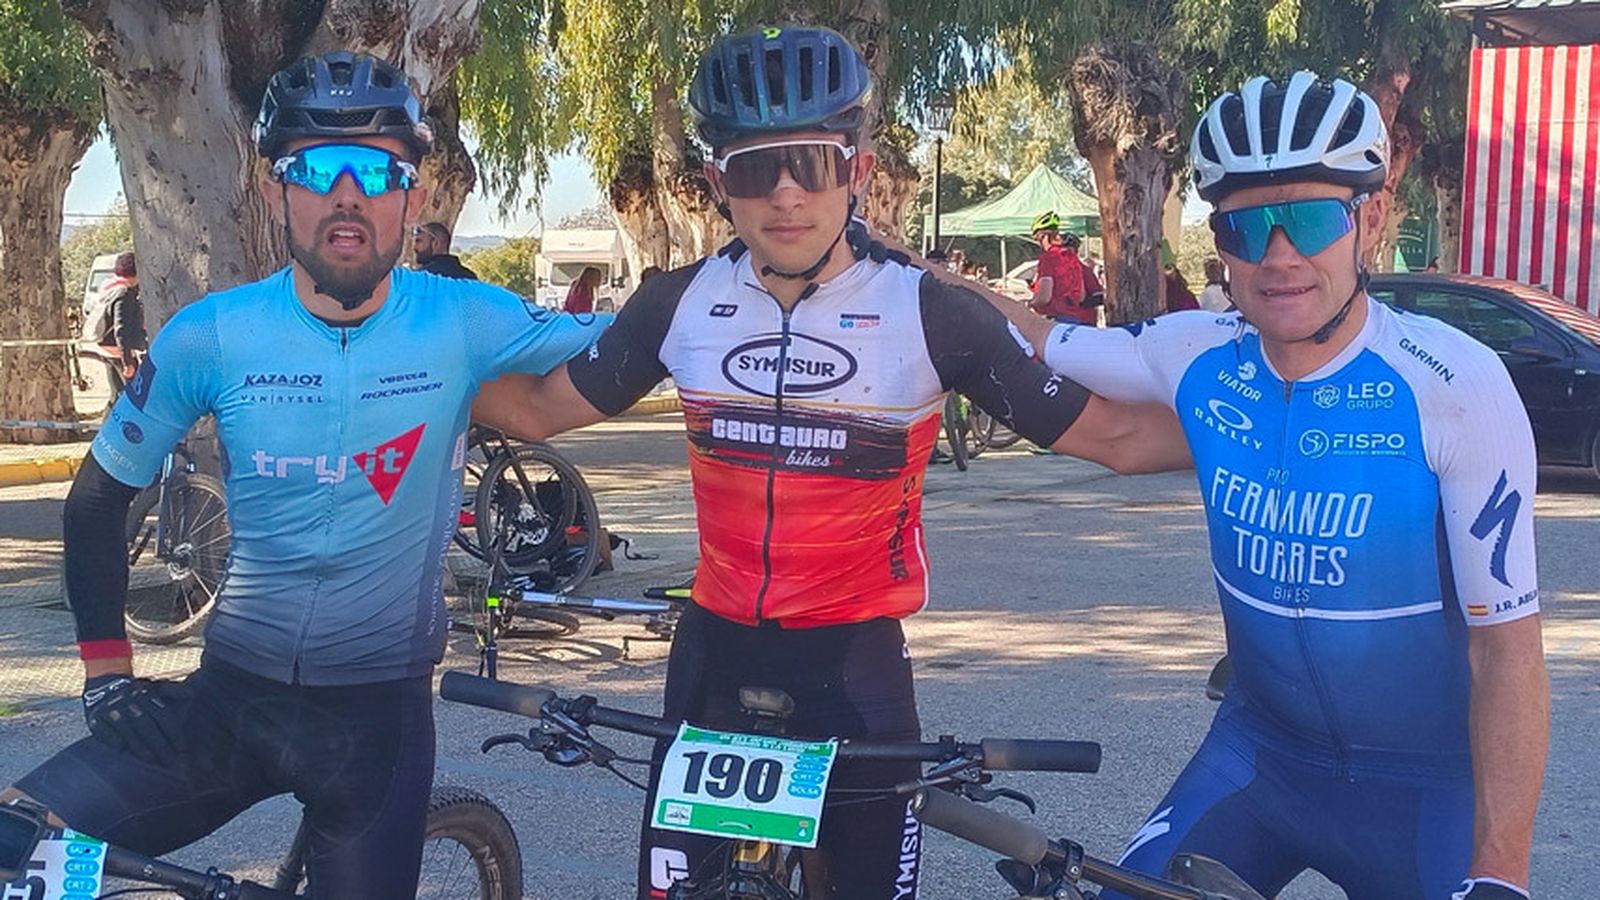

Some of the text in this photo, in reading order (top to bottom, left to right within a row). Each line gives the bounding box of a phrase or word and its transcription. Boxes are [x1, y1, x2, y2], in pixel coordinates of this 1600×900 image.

[738, 355, 836, 378] SYMISUR
[1398, 338, 1455, 385] GARMIN
[244, 374, 323, 388] KAZAJOZ
[360, 382, 444, 400] ROCKRIDER
[1217, 369, 1262, 402] VIATOR
[1347, 381, 1395, 399] LEO
[1346, 399, 1395, 410] GRUPO
[1194, 407, 1263, 449] OAKLEY
[1333, 433, 1405, 449] FISPO
[784, 449, 832, 468] bikes
[1211, 466, 1374, 538] FERNANDO
[1232, 525, 1348, 587] TORRES
[682, 751, 784, 804] 190
